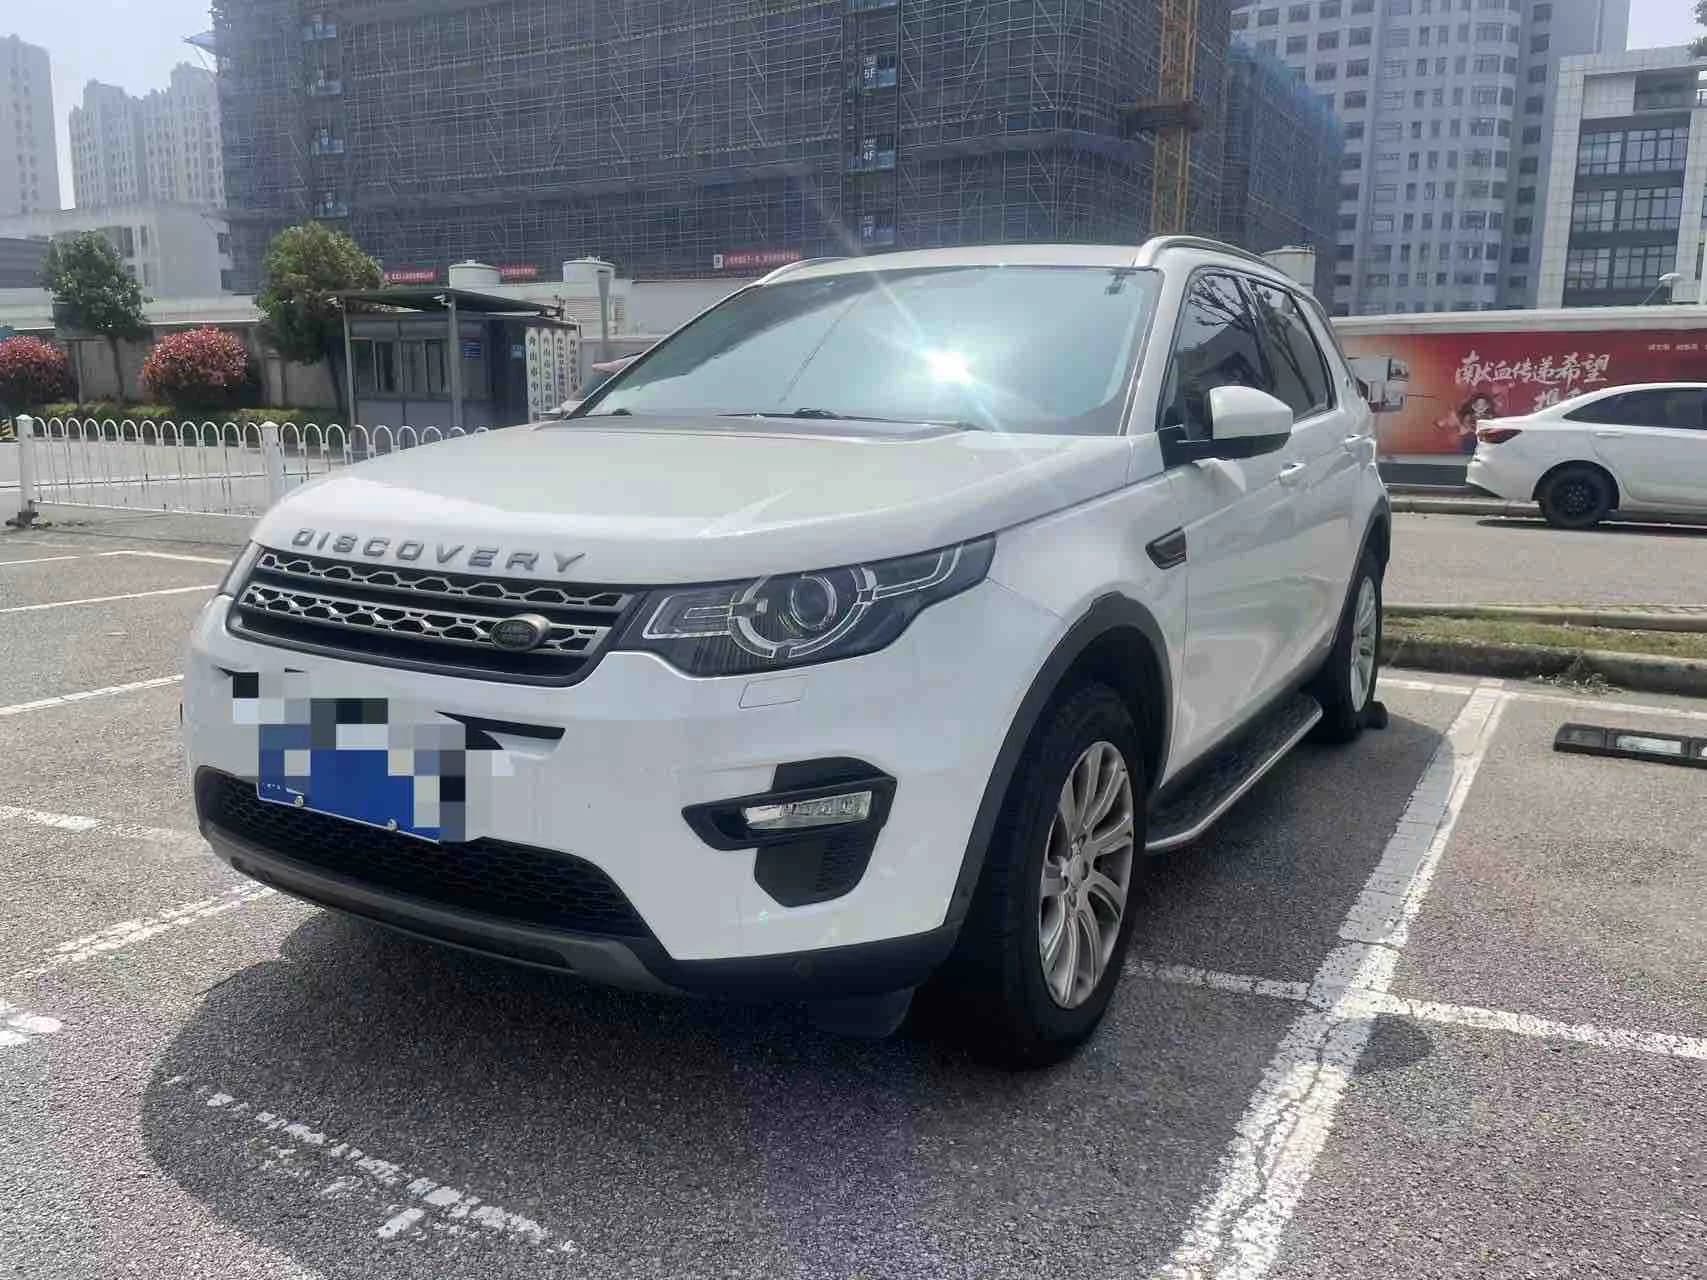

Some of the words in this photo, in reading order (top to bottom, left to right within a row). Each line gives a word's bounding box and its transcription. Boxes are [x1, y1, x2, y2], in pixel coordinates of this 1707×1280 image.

[1455, 350, 1610, 389] 献血传递希望
[291, 527, 586, 573] DISCOVERY
